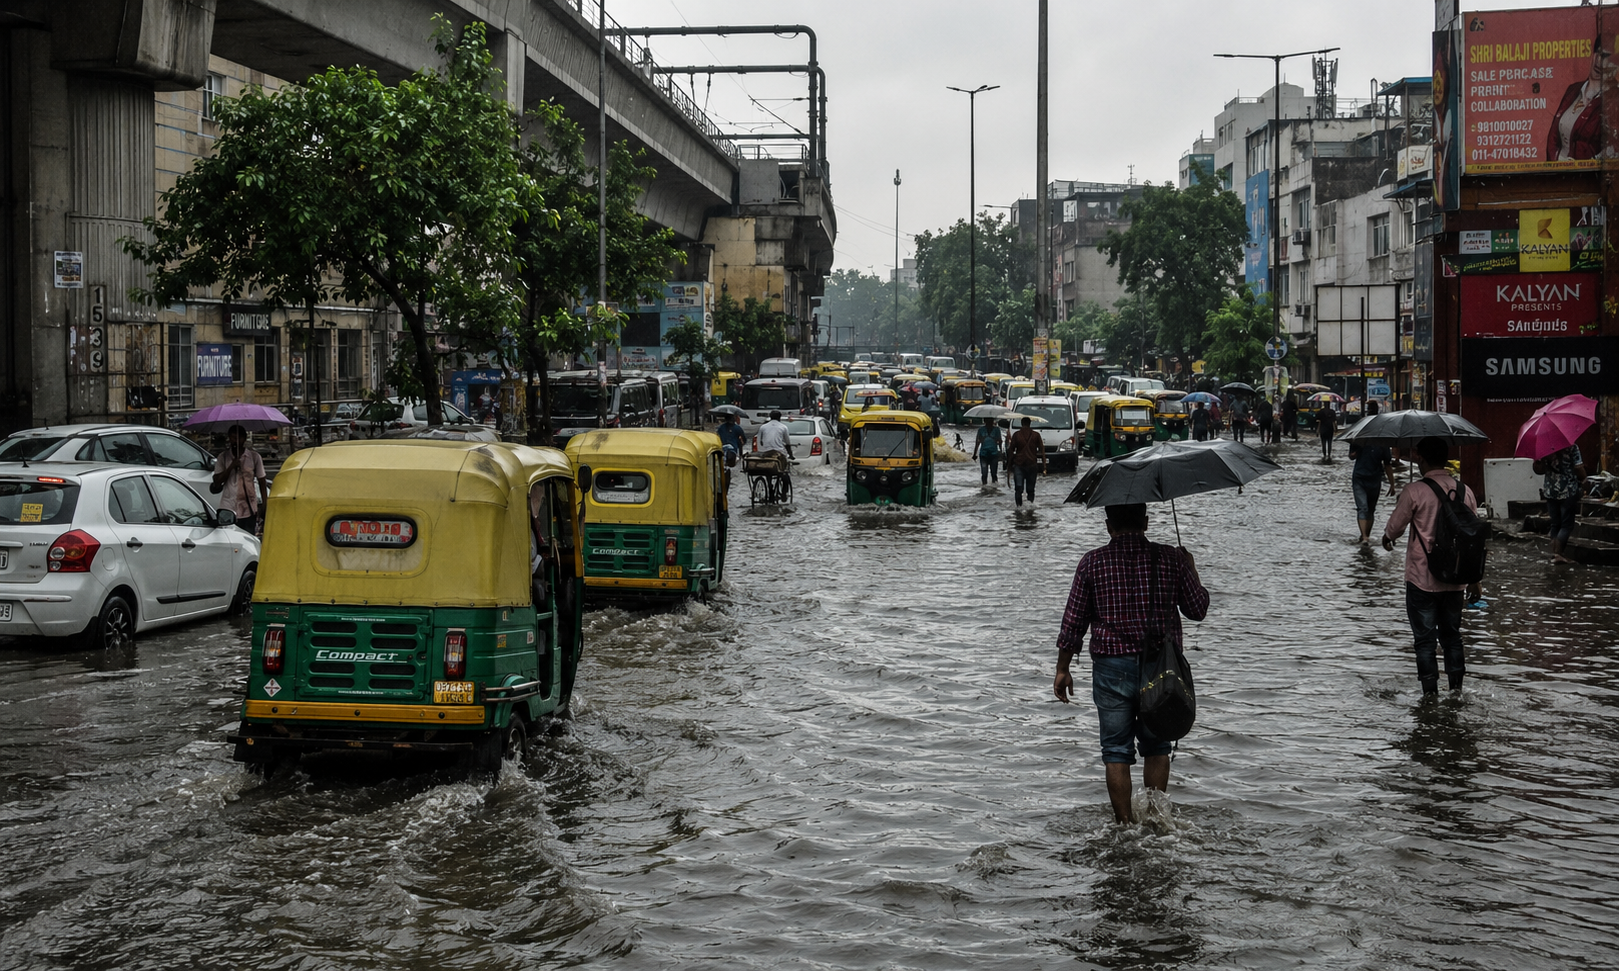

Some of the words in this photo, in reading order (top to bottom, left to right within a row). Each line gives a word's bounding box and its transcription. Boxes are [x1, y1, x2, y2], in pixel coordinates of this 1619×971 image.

[1470, 44, 1493, 63] SHRI
[1496, 42, 1530, 62] BALAJI
[1532, 39, 1592, 60] PROPERTIES
[1470, 69, 1496, 82] SALE
[1470, 98, 1547, 112] COLLABORATION
[1521, 243, 1569, 255] KALYAN
[1496, 283, 1580, 302] KALYAN
[1511, 303, 1562, 312] PRESENTS
[1485, 356, 1601, 376] SAMSUNG
[315, 649, 399, 662] Compact
